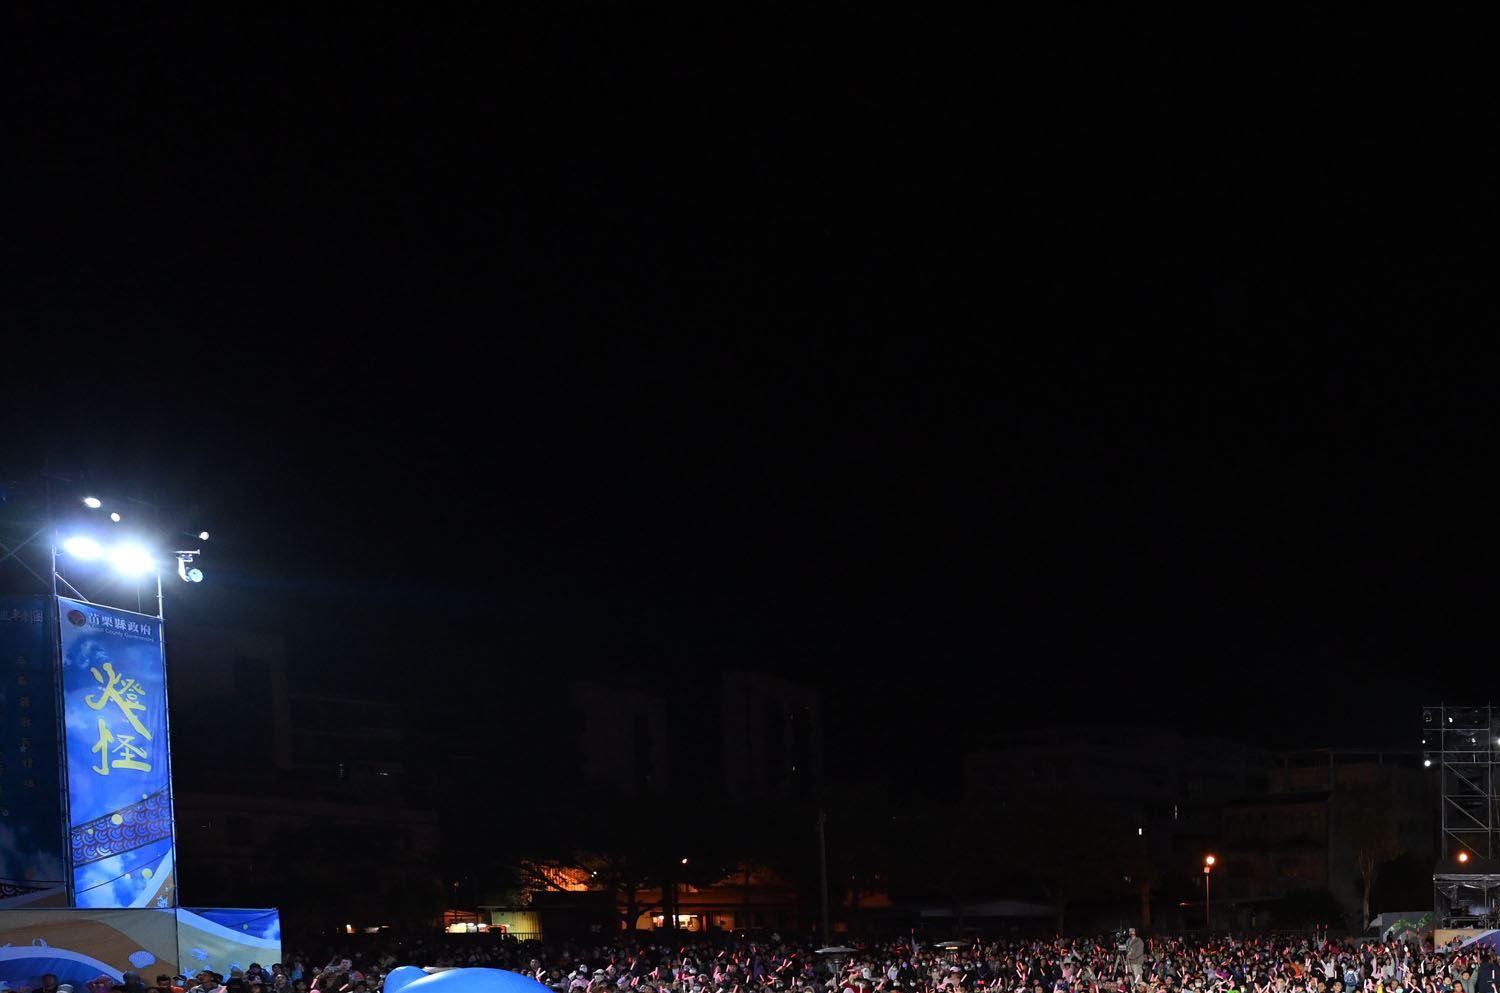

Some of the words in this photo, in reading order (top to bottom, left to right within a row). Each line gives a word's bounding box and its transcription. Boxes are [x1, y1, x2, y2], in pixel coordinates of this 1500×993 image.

[88, 612, 151, 635] 苗栗縣政府
